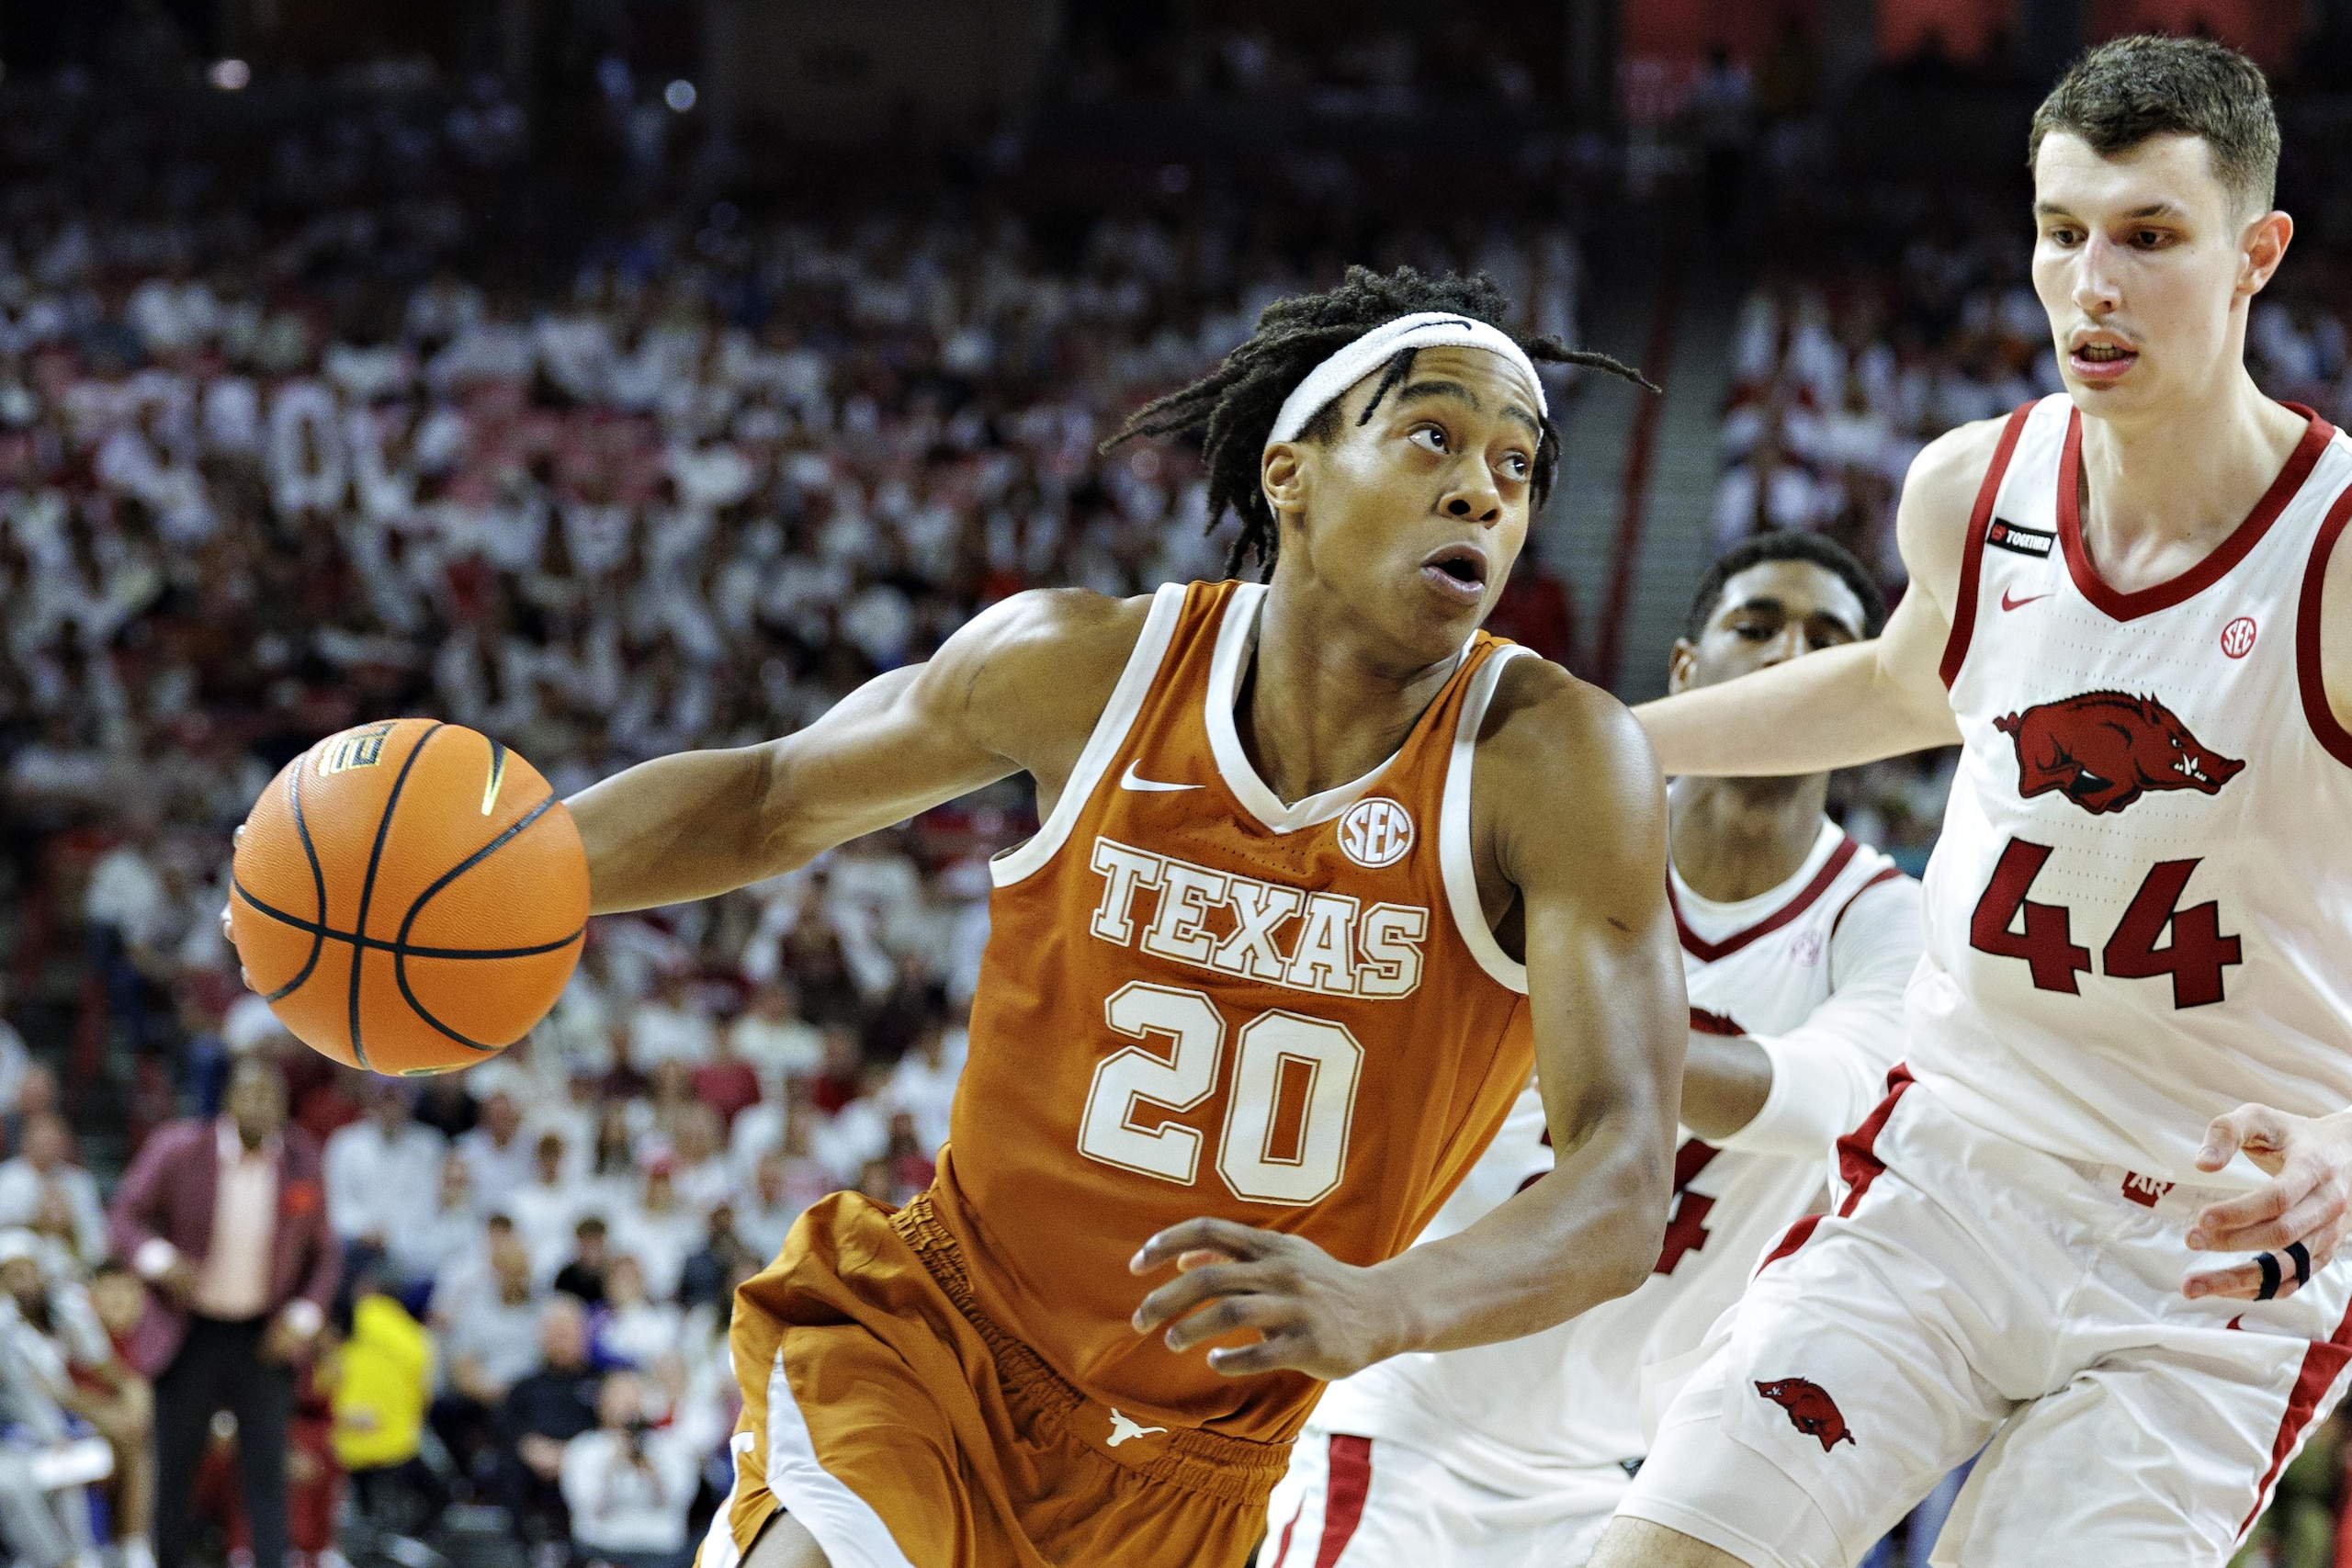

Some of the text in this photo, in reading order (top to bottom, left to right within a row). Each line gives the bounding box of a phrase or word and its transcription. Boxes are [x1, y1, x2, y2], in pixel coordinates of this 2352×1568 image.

[2223, 619, 2255, 654] SEC
[1344, 803, 1408, 862] SEC
[1090, 836, 1429, 1000] TEXAS
[1970, 836, 2243, 1010] 44
[1078, 980, 1365, 1206] 20
[2128, 1173, 2168, 1199] AR
